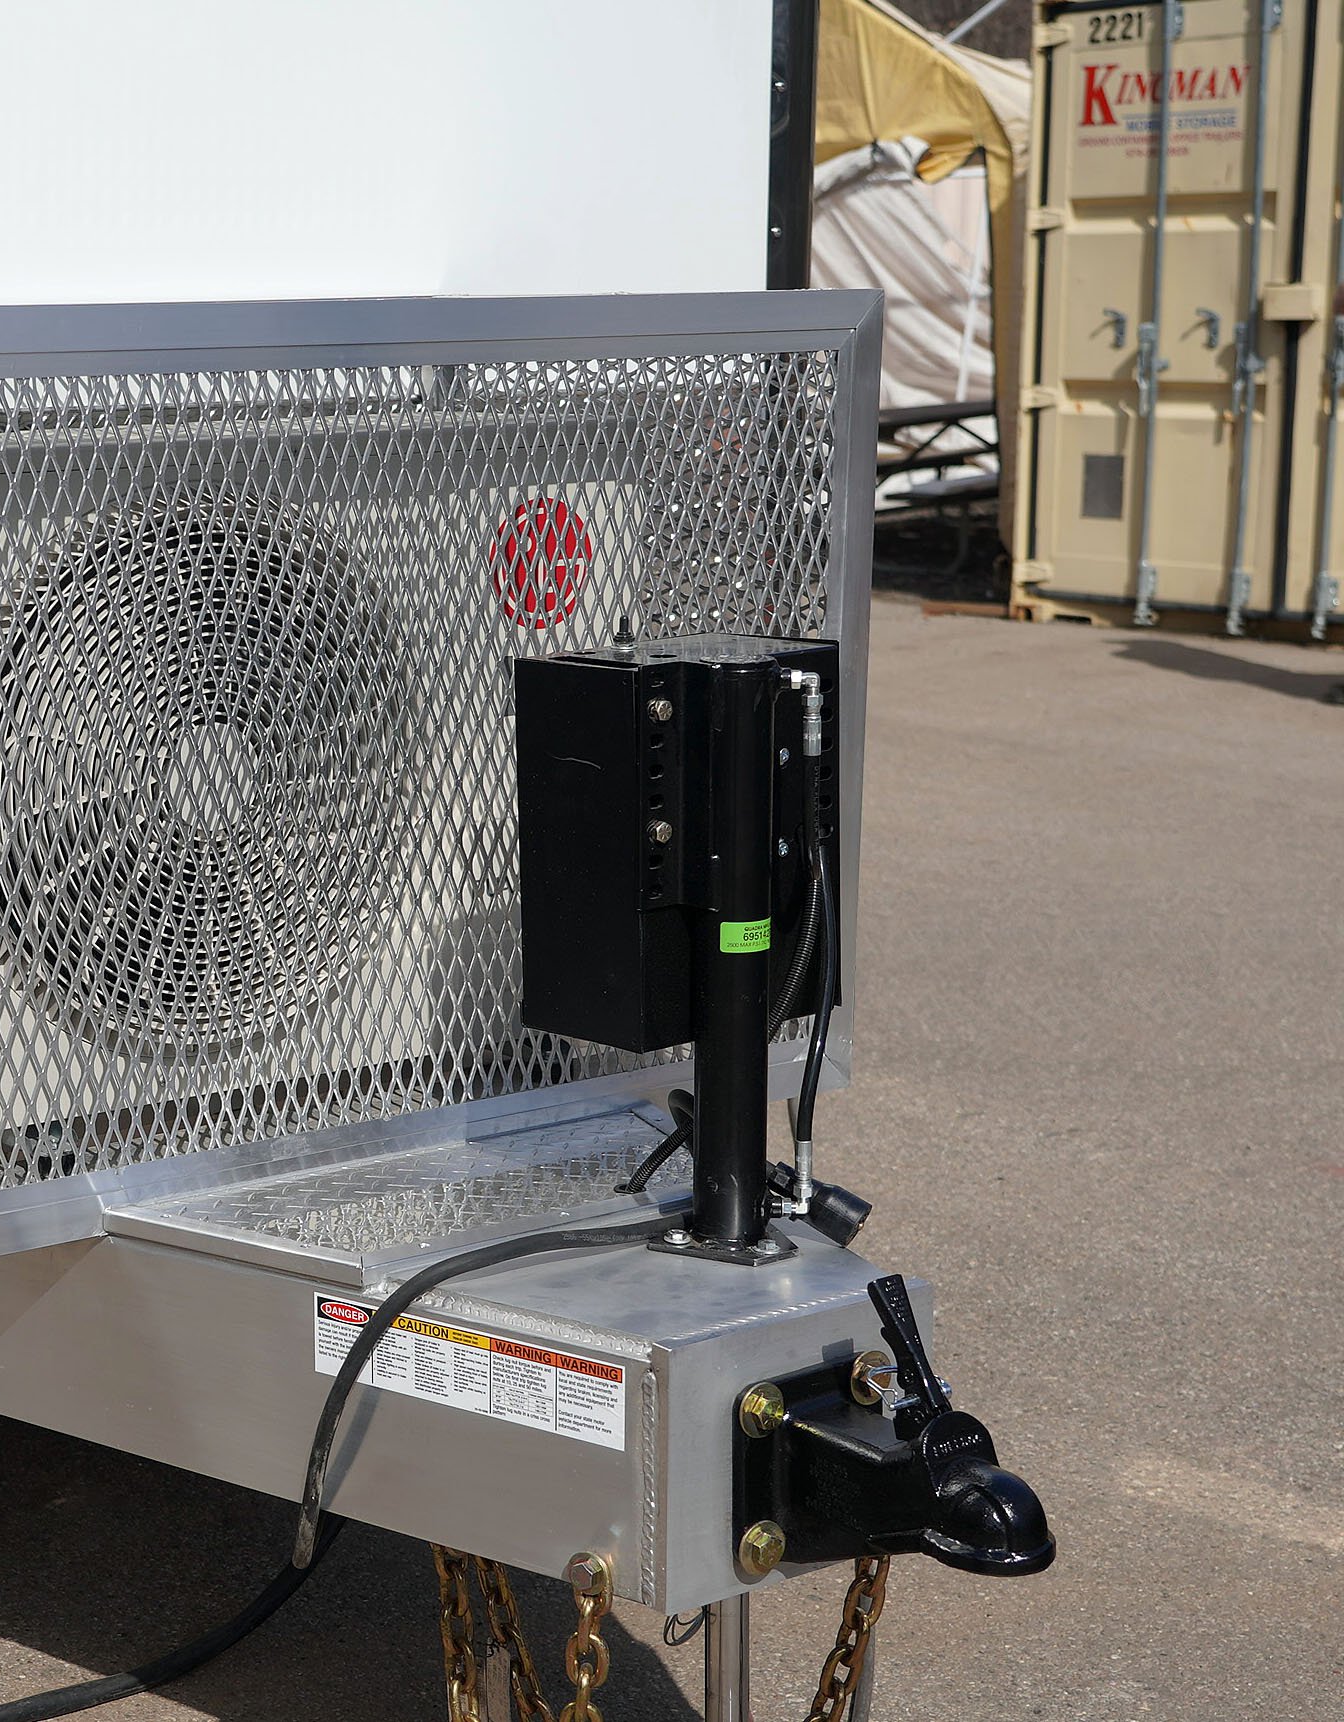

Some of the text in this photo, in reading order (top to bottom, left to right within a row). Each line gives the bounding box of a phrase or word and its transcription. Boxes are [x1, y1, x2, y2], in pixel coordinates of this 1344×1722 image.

[1089, 13, 1143, 44] 2221
[325, 1304, 365, 1322] DANGER
[398, 1318, 449, 1339] CAUTION
[495, 1340, 552, 1364] WARNING
[560, 1356, 618, 1380] WARNING
